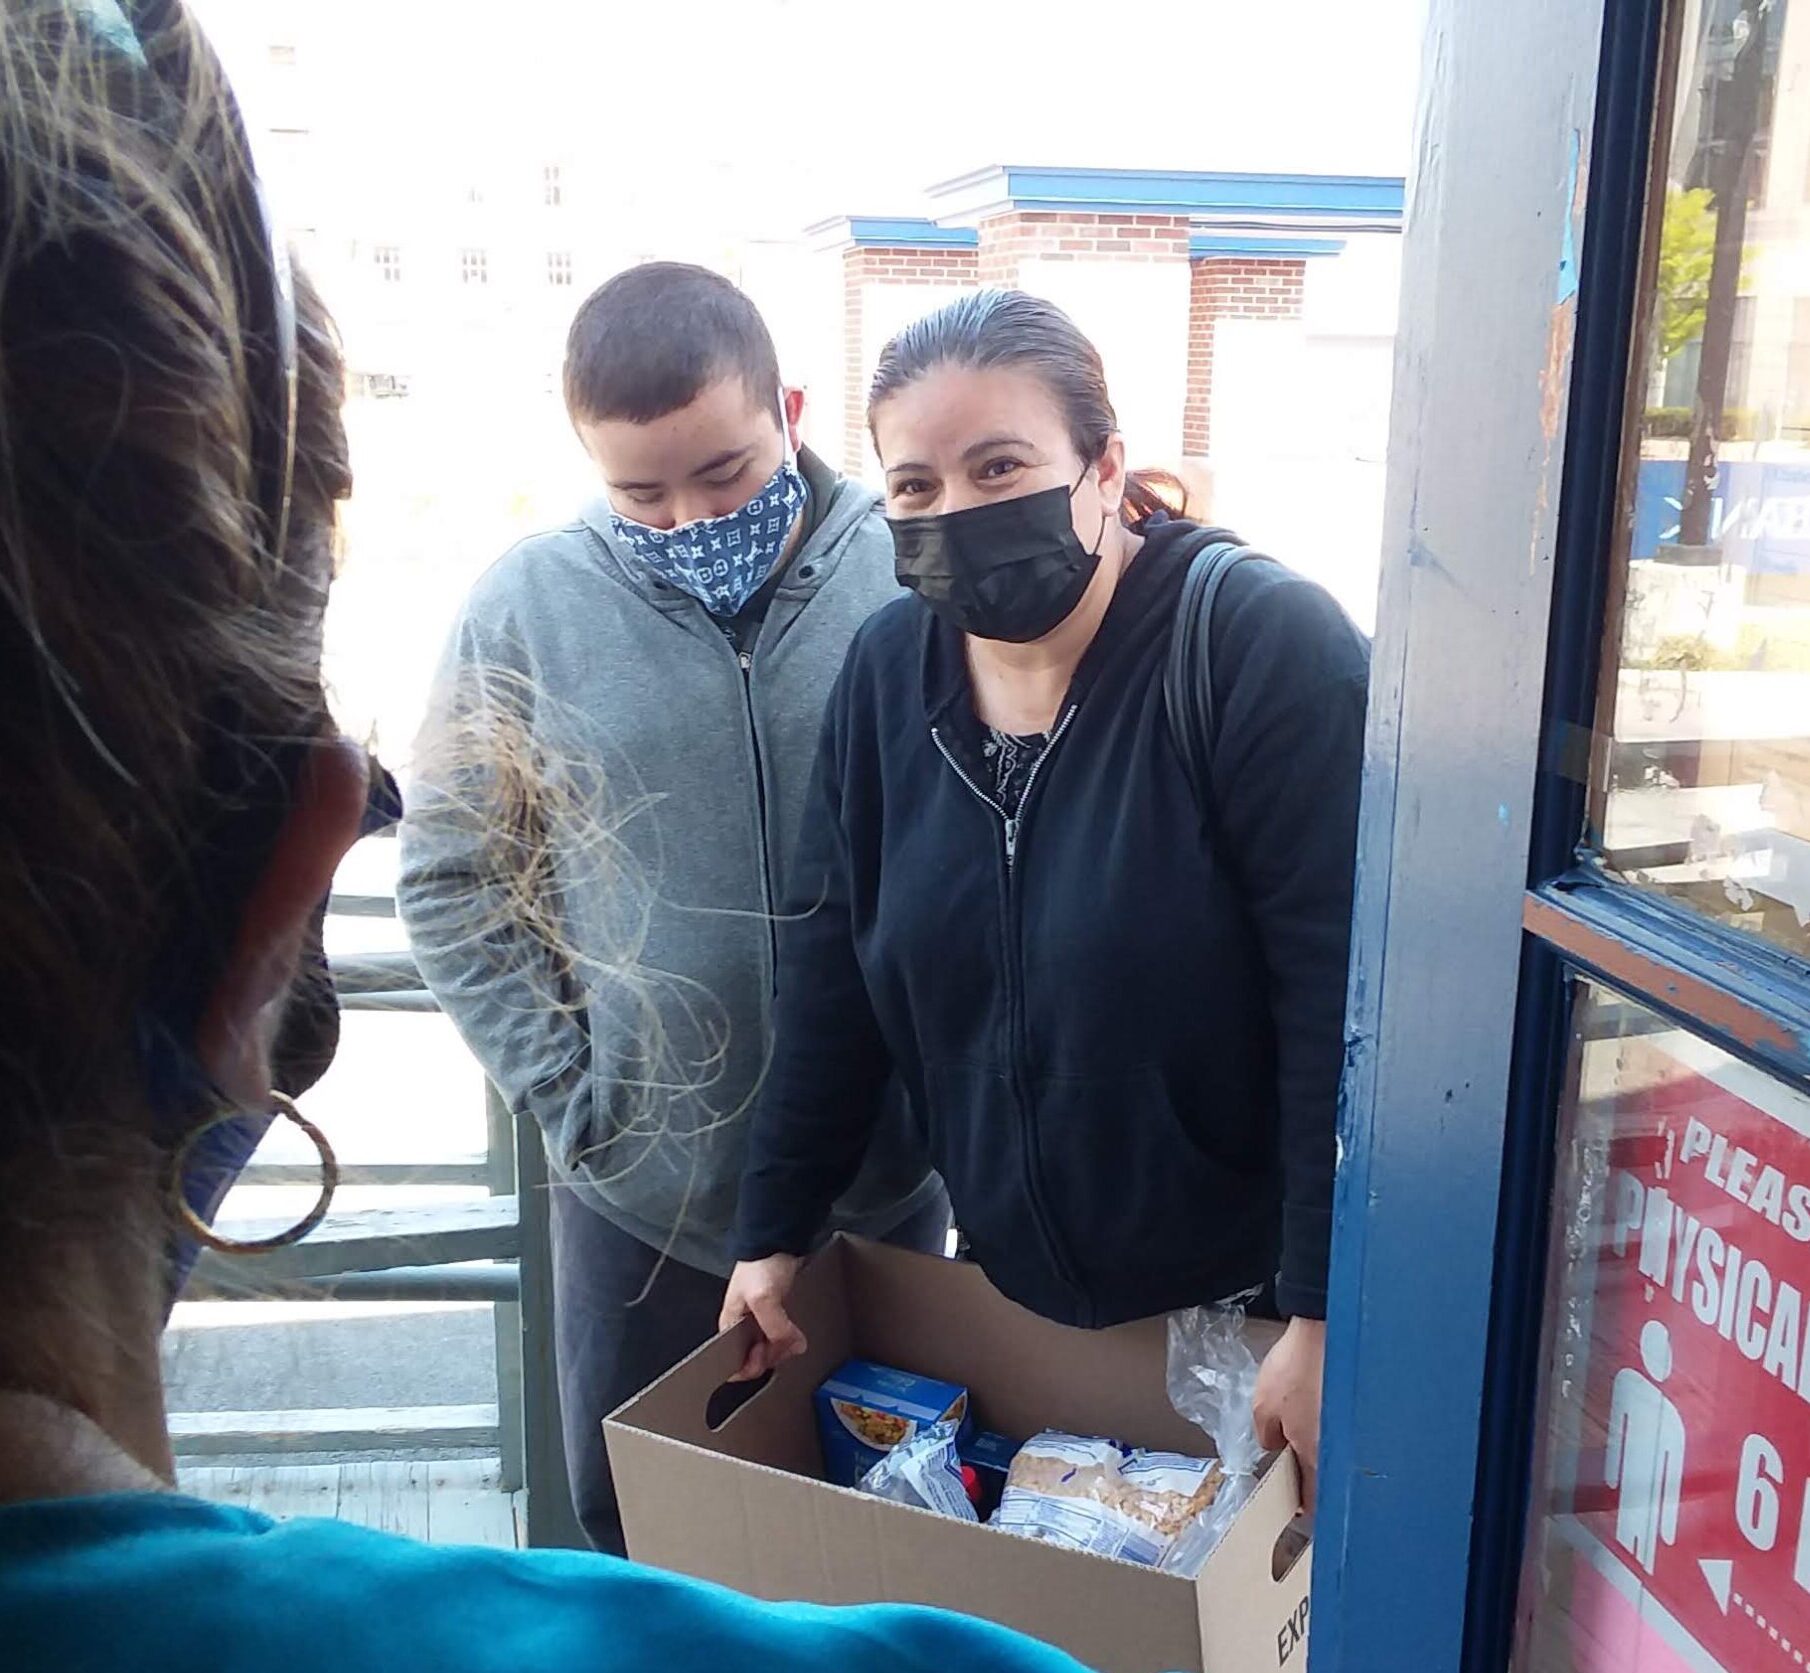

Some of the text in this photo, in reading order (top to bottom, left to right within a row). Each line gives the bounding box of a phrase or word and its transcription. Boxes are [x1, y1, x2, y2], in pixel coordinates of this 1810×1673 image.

[1679, 1115, 1810, 1242] PLEAS
[1736, 1433, 1784, 1551] 6
[1278, 1595, 1309, 1668] EXP
